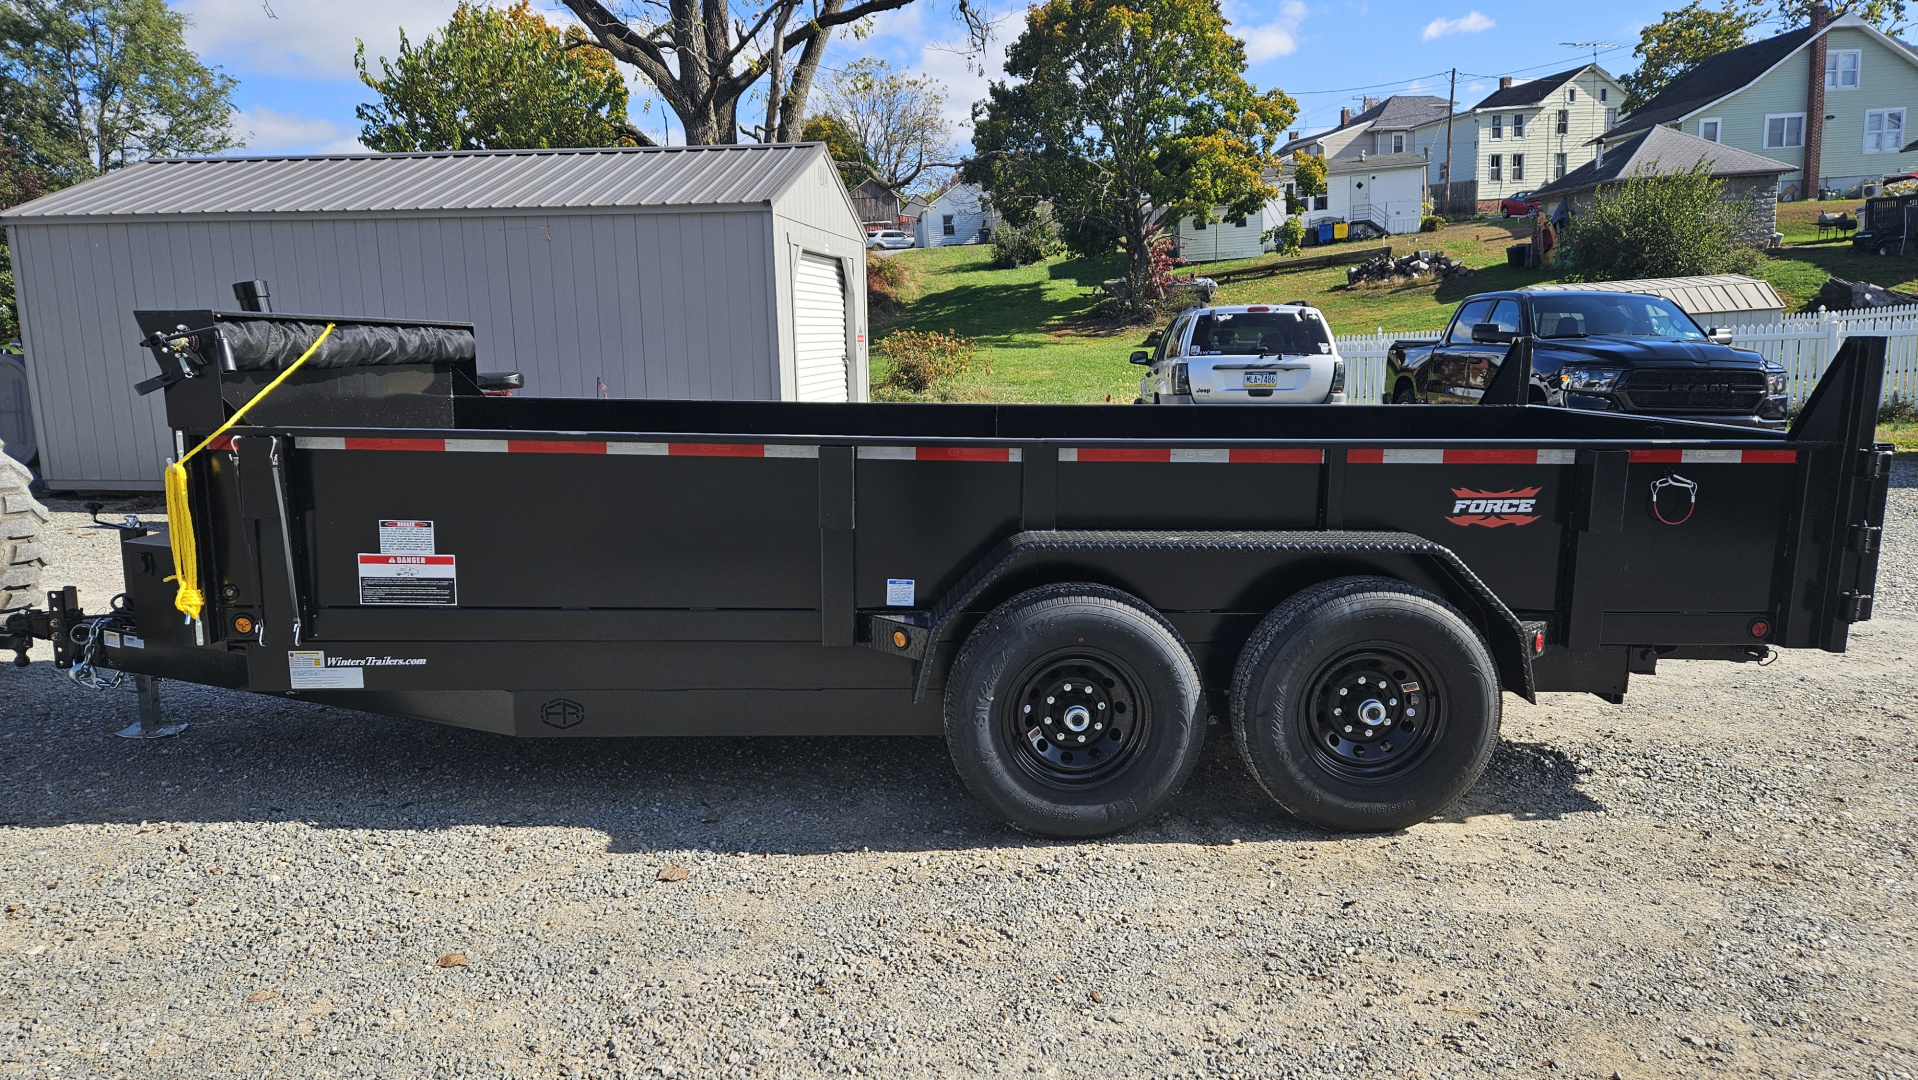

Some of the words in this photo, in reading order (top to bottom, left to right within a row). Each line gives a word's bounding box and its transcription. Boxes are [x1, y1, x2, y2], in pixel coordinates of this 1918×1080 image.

[1452, 499, 1537, 514] FORCE
[396, 556, 426, 564] DANGER
[327, 656, 427, 666] WintersTrailers.com
